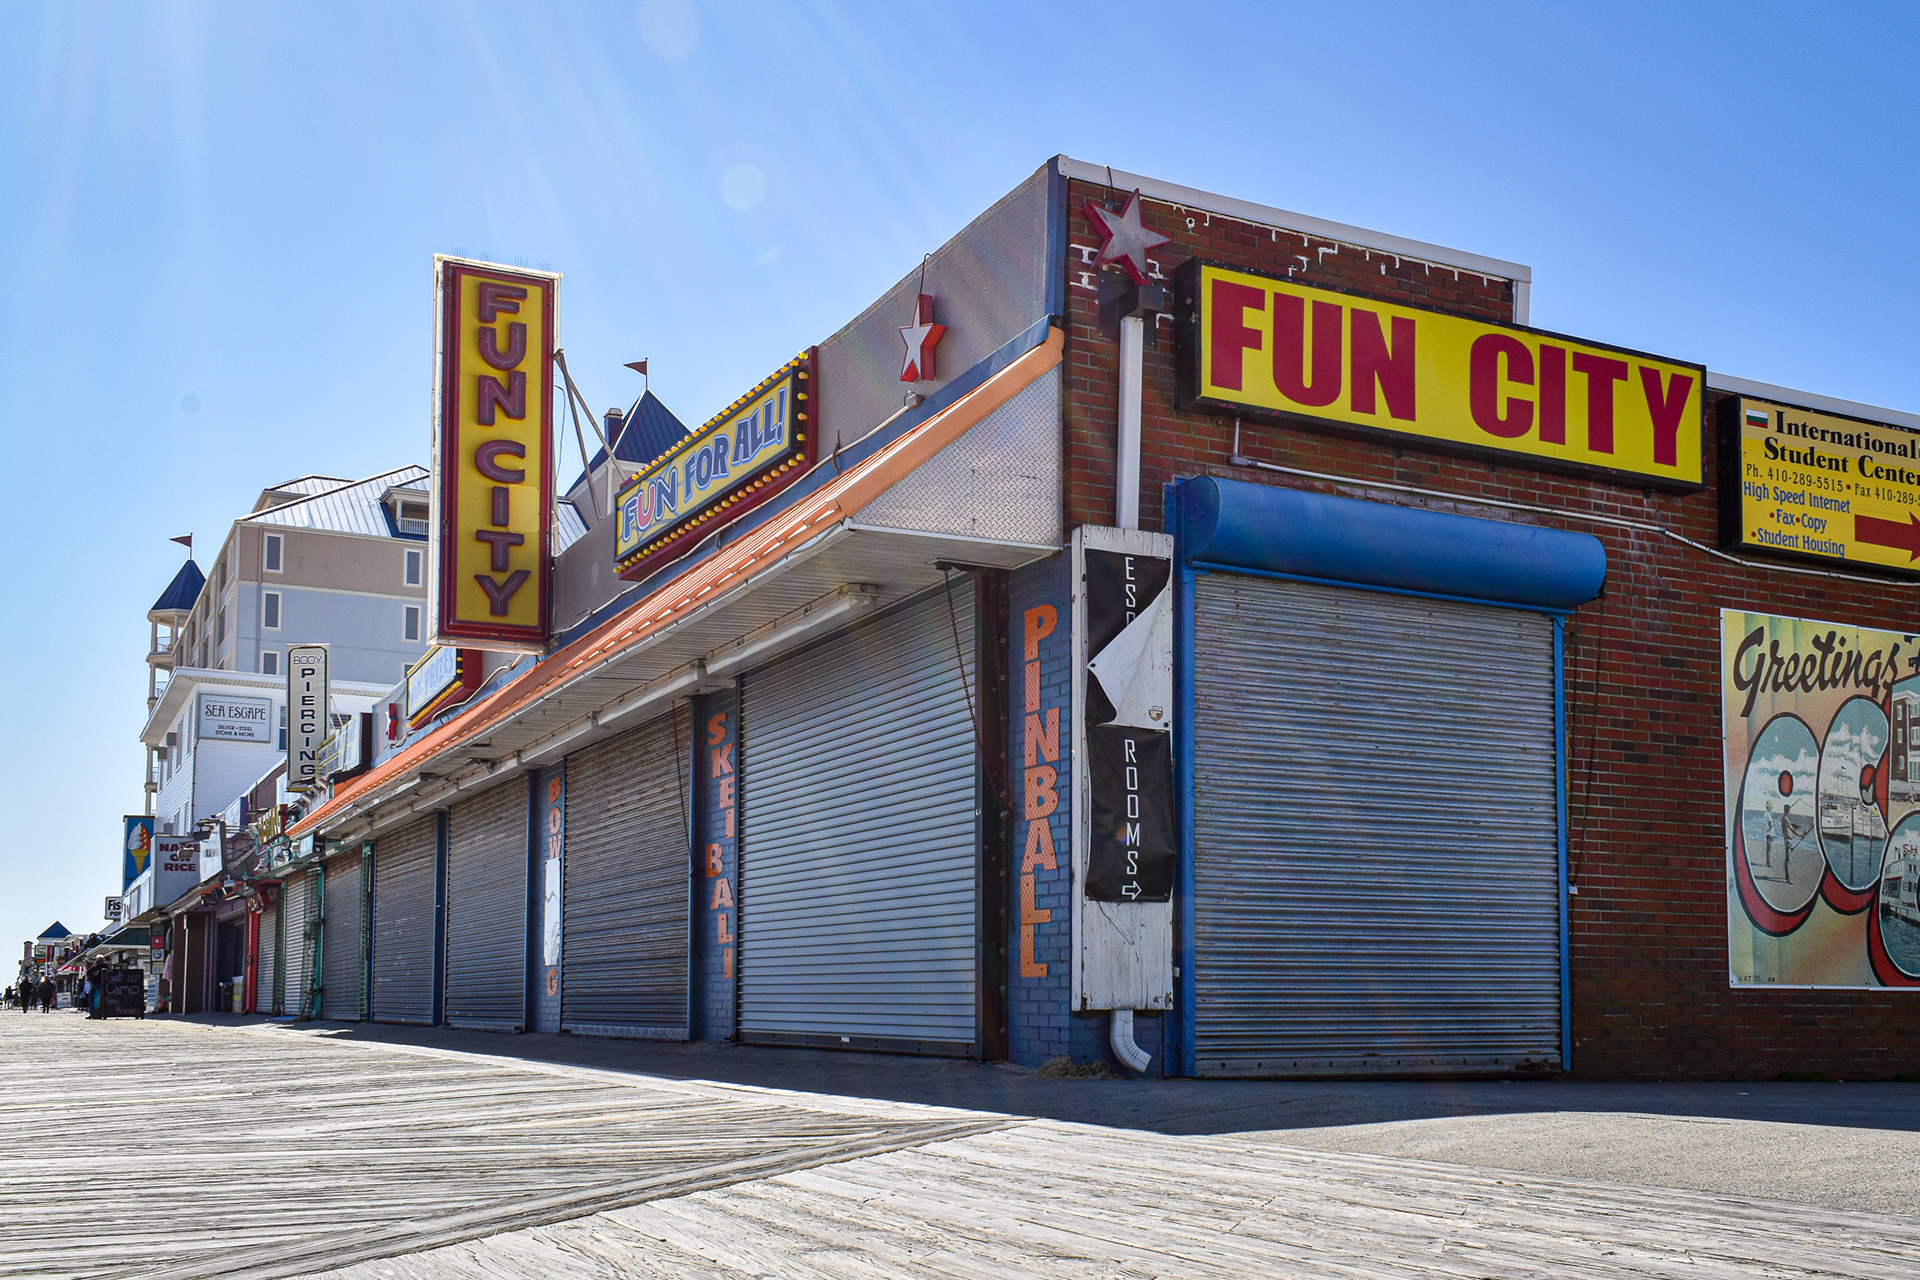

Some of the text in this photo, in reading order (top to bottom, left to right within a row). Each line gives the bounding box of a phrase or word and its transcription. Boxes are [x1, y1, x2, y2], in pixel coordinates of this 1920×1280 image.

[1210, 278, 1694, 467] FUN CITY
[474, 281, 532, 616] FUN CITY
[1764, 436, 1849, 473] Student
[1775, 410, 1917, 459] International
[623, 387, 787, 543] FUN FOR ALL!
[1746, 463, 1763, 478] Ph.
[1767, 467, 1844, 493] 410-289-5515
[1854, 483, 1871, 498] Fax
[1743, 481, 1851, 514] High Speed Internet
[1776, 509, 1827, 534] Fax Copy
[1757, 528, 1845, 559] Student Housing
[293, 655, 323, 664] BODY
[1733, 626, 1900, 717] Greetings
[205, 704, 266, 720] SEA ESCAPE
[299, 667, 316, 776] PIERCING
[1019, 603, 1059, 978] PINBALL
[1124, 739, 1140, 876] ROOMS
[164, 863, 196, 871] RICE
[546, 776, 562, 997] BOWG
